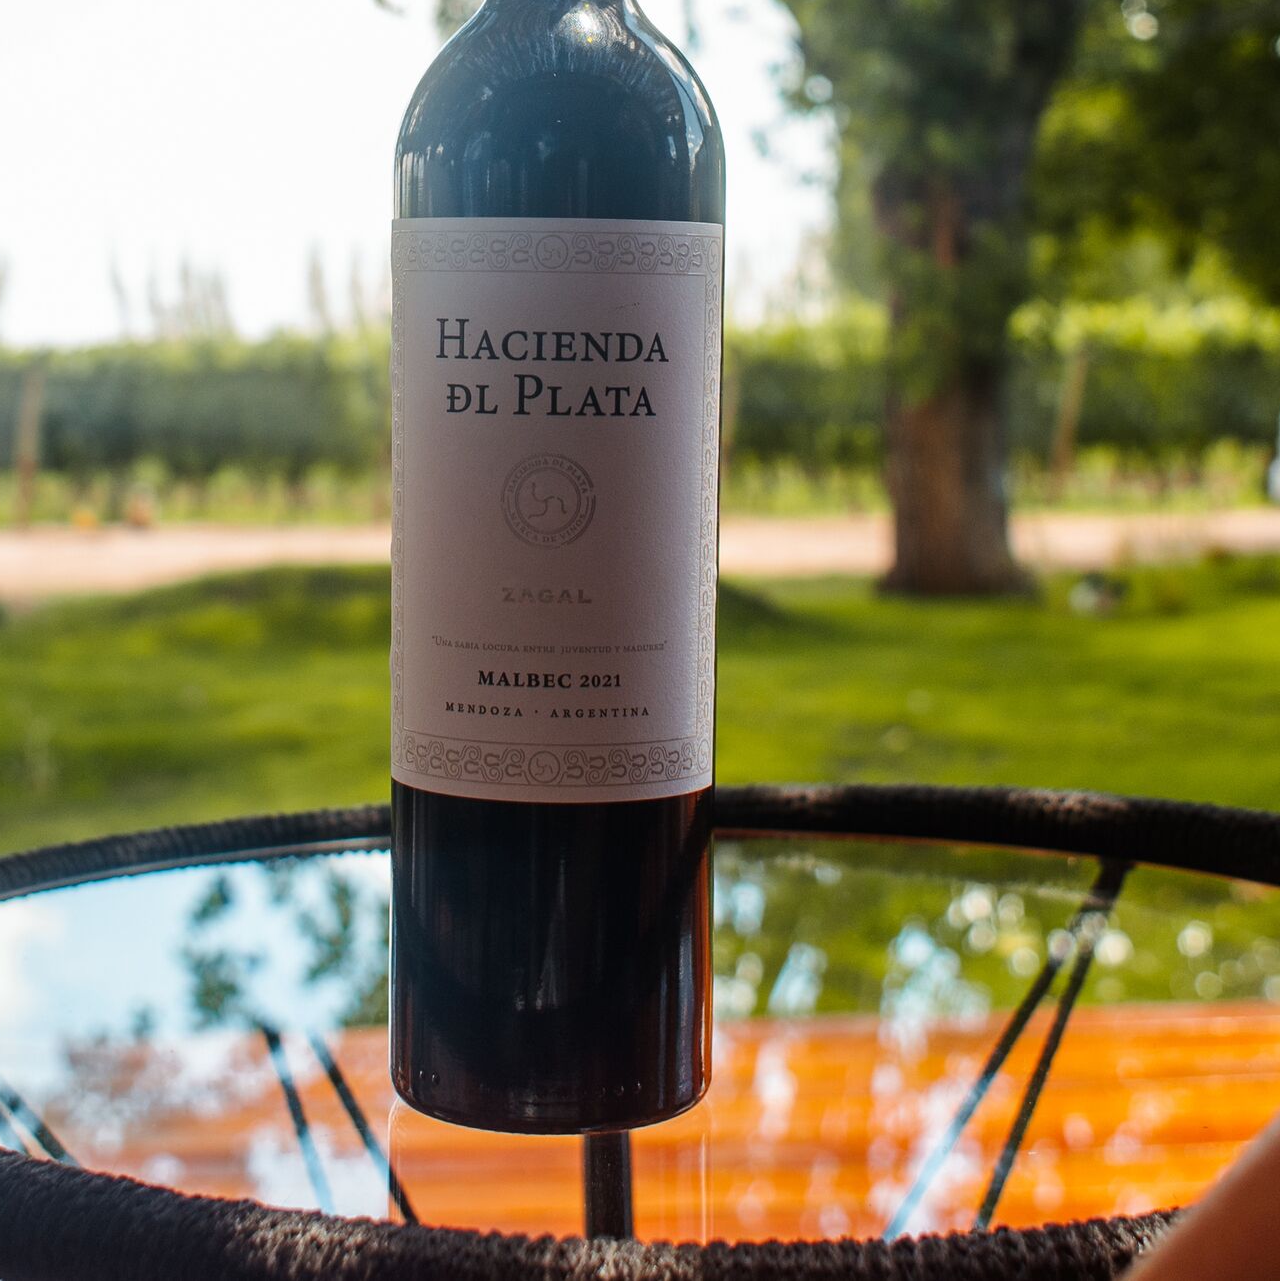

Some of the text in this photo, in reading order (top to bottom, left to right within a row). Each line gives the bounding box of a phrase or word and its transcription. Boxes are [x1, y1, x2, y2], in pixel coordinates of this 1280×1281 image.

[435, 318, 669, 363] HACIENDA
[513, 374, 656, 417] PLATA
[501, 587, 592, 604] ZAGAL
[482, 643, 520, 653] LOCURA
[523, 645, 556, 654] ENTRE
[560, 645, 612, 655] JUVENTUD
[614, 645, 621, 654] Y
[478, 670, 621, 689] MALBEC 2021
[445, 701, 650, 718] MENDOZA ARGENTINA
